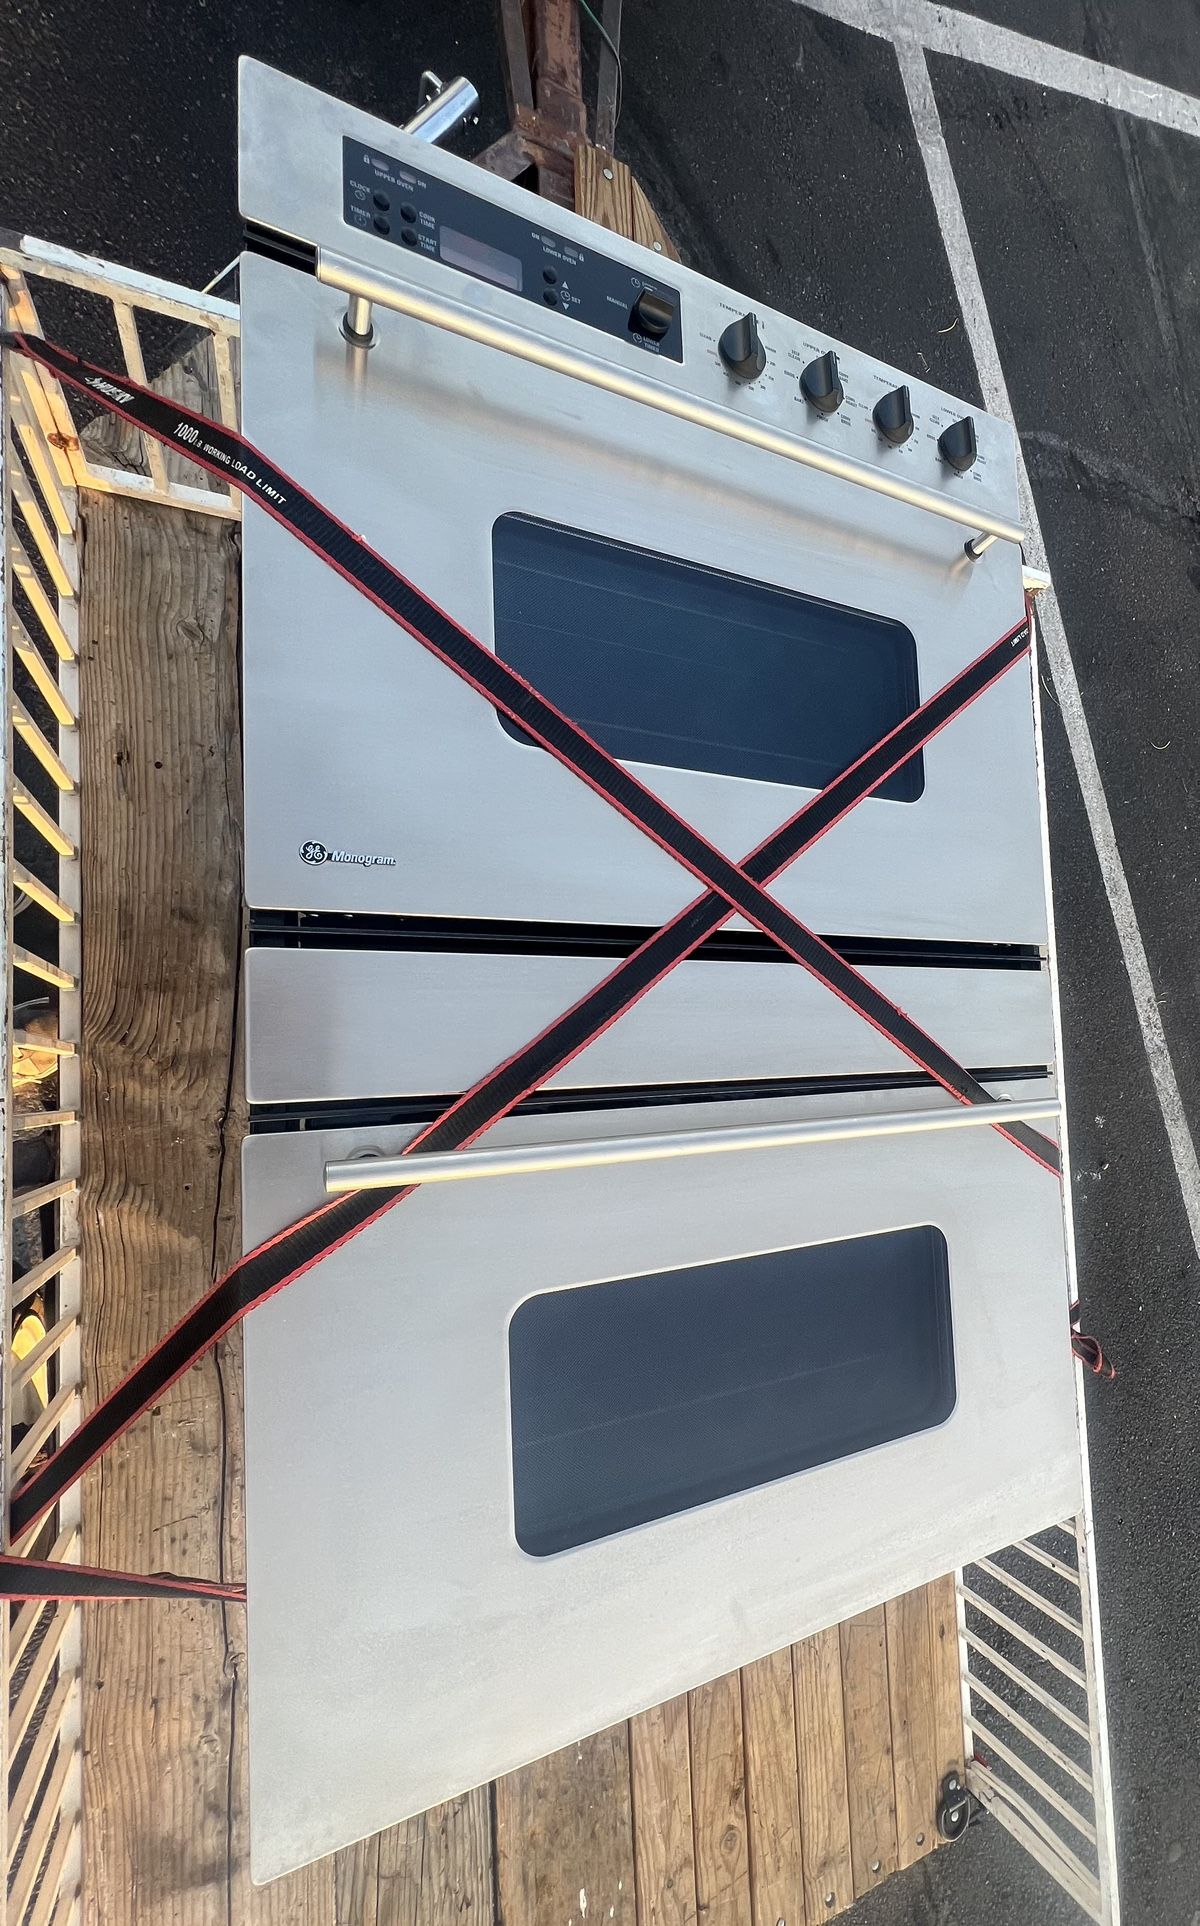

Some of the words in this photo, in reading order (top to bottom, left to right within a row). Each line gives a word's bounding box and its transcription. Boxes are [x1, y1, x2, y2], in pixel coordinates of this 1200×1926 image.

[349, 179, 371, 193] CLOCK
[374, 169, 396, 183] UPPER
[396, 179, 414, 192] OVEN
[417, 179, 427, 188] ON
[350, 204, 371, 218] TIMER
[418, 211, 436, 223] COOK
[420, 218, 435, 230] TIME
[418, 233, 437, 246] START
[531, 232, 540, 240] ON
[420, 241, 435, 253] TIME
[542, 246, 562, 259] LOWER
[562, 254, 577, 266] OVEN
[571, 296, 581, 305] SET
[606, 295, 628, 309] MANUAL
[173, 422, 200, 444] 1000
[202, 443, 231, 465] WORKING
[231, 459, 257, 480] LOAD
[255, 478, 287, 504] LIMIT
